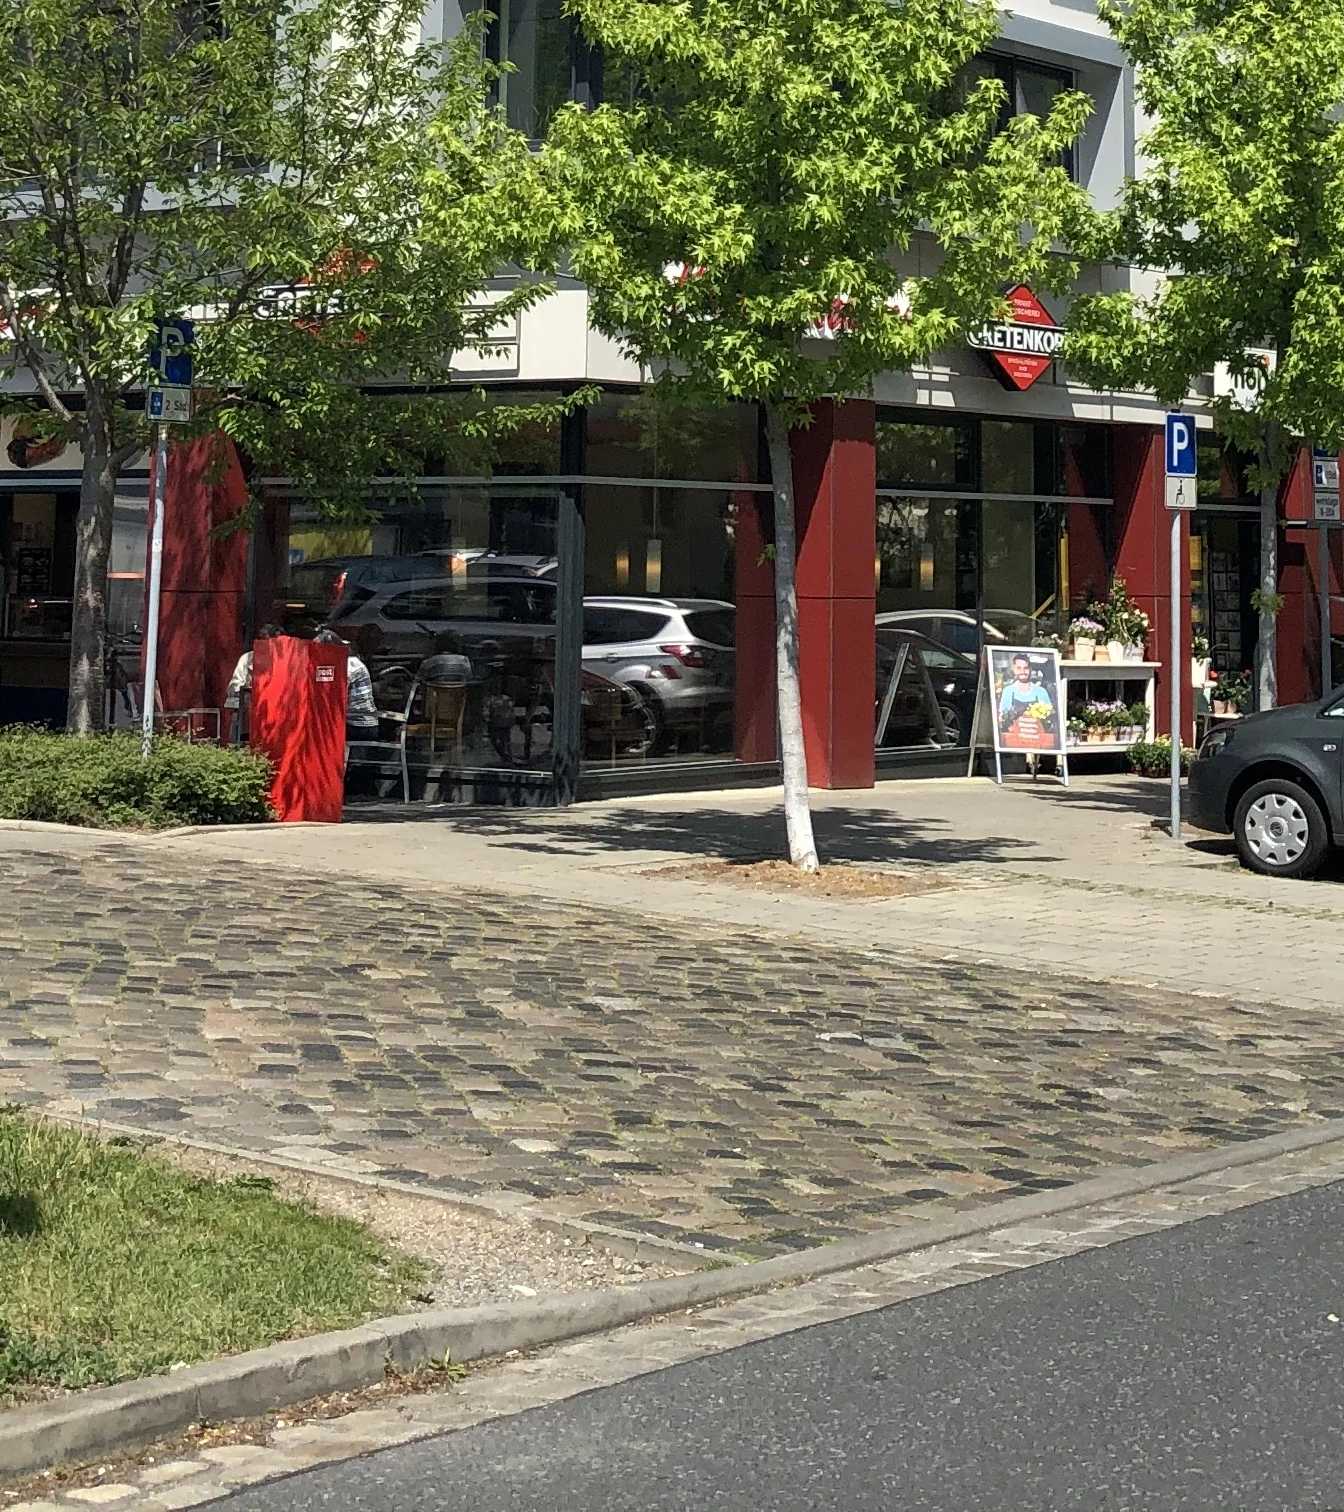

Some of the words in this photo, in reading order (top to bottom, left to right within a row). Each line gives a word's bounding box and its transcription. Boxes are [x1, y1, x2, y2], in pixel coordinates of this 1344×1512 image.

[159, 326, 185, 380] P
[968, 322, 1067, 354] GRETENKOR
[1172, 422, 1189, 467] P
